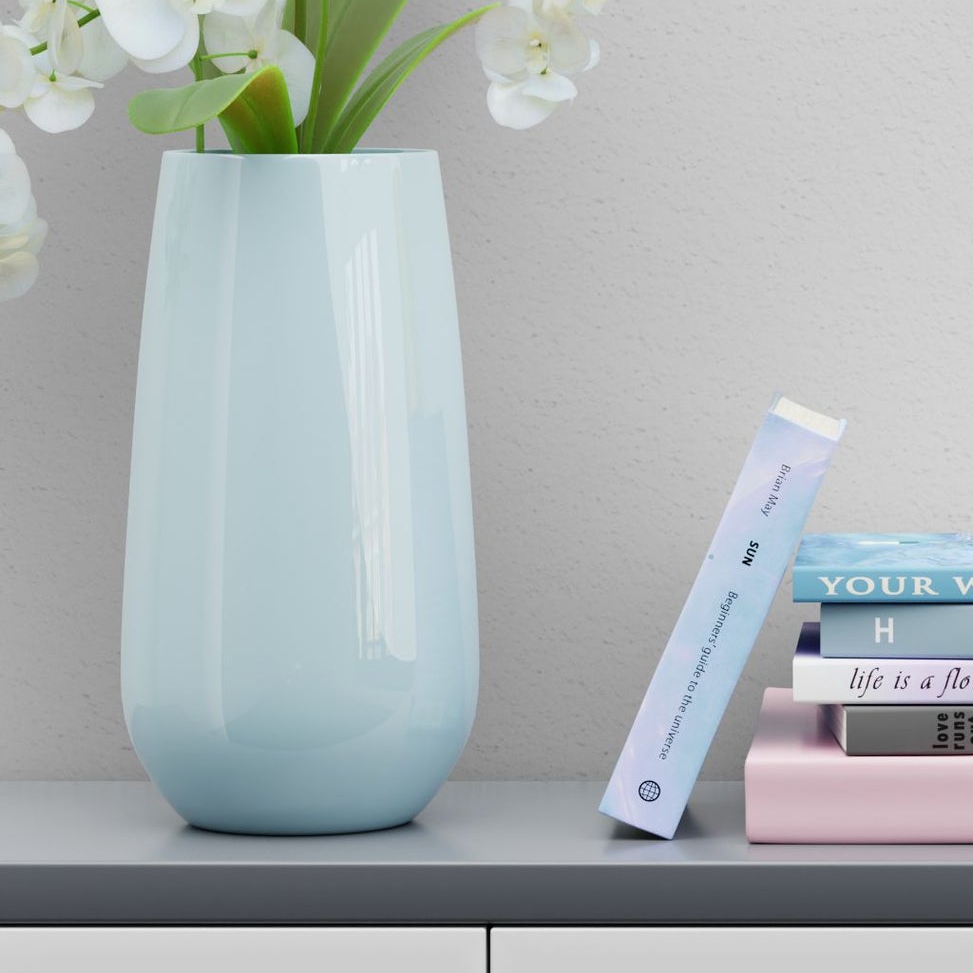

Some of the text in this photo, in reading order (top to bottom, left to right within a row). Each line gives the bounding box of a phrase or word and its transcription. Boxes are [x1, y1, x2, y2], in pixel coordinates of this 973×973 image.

[760, 463, 792, 517] Brian May
[742, 540, 760, 567] SUN
[818, 576, 940, 596] YOUR
[659, 590, 739, 760] Beginners' guide to the universe
[849, 667, 884, 698] life
[894, 670, 911, 690] is
[920, 675, 933, 690] a
[932, 713, 949, 749] love
[953, 711, 965, 750] runs
